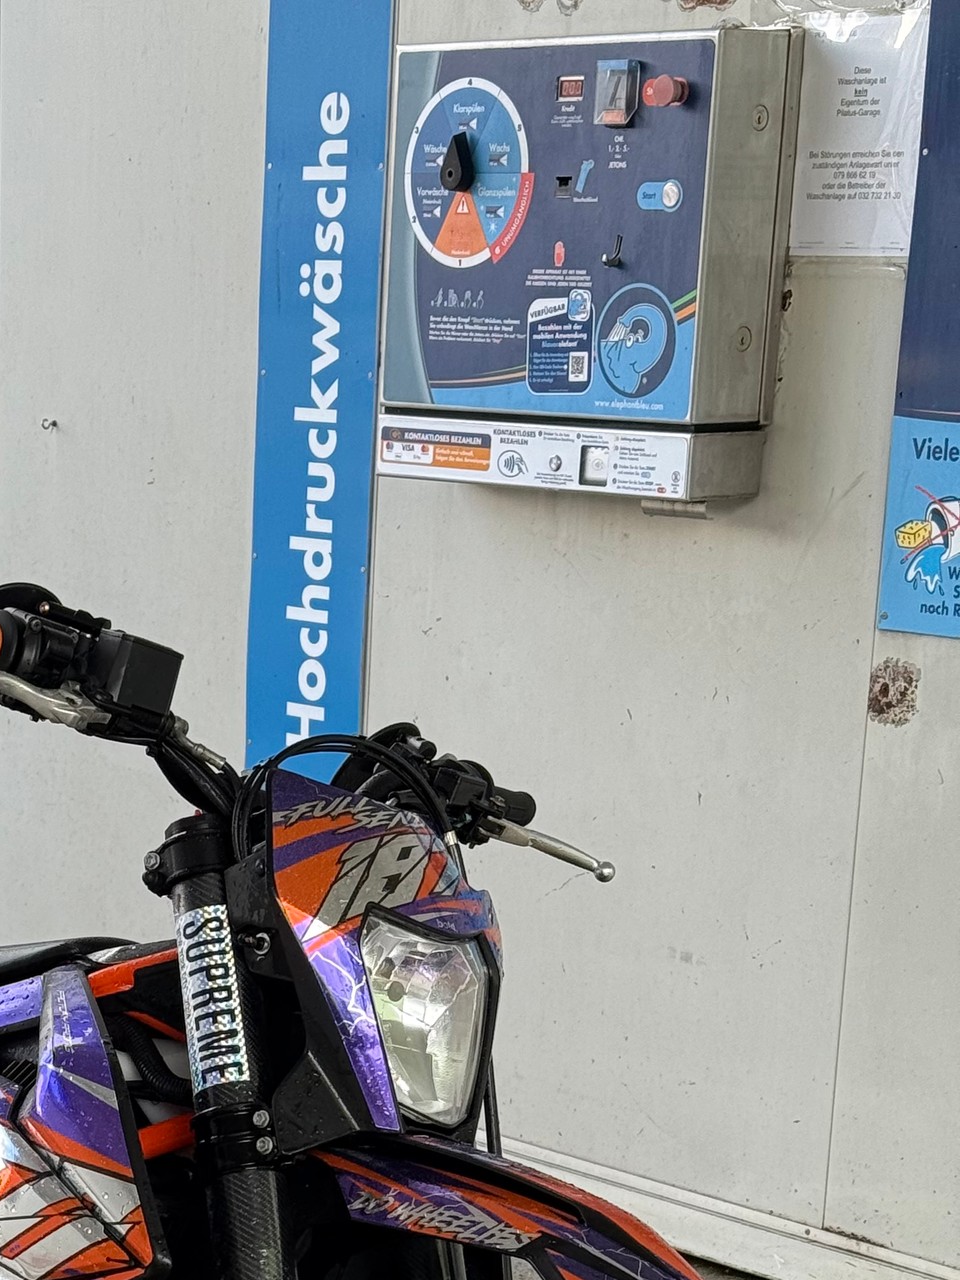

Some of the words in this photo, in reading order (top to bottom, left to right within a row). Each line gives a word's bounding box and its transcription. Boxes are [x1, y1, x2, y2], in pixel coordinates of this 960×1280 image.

[853, 66, 872, 75] Diese
[467, 78, 473, 86] 4
[837, 77, 878, 86] Waschanlage
[854, 87, 868, 97] kein
[840, 98, 869, 107] Eigentum
[870, 97, 881, 106] der
[453, 102, 485, 115] Klarspülen
[836, 108, 881, 117] Pilatus-Garage
[414, 126, 420, 135] 3
[423, 143, 448, 153] Wäsche
[489, 142, 511, 152] Wachs
[809, 150, 819, 159] Bei
[820, 150, 851, 160] Störungen
[881, 149, 891, 158] Sie
[822, 181, 836, 189] oder
[875, 181, 886, 189] der
[416, 186, 449, 197] Vorwäsche
[477, 186, 516, 199] Glanzspülen
[642, 192, 657, 200] Start
[806, 192, 846, 201] Waschanlage
[494, 245, 501, 255] 6
[529, 303, 566, 319] VERFÜGBAR
[594, 400, 664, 411] www.elephantbleu.com
[285, 91, 350, 747] Hochdruckwäsche
[493, 428, 537, 438] KONTAKTLOSES
[404, 431, 450, 443] KONTAKTLOSES
[450, 434, 482, 446] BEZAHLEN
[500, 438, 529, 446] BEZAHLEN
[920, 602, 949, 616] noch
[285, 795, 376, 829] FULL
[182, 916, 245, 1085] SUPREME
